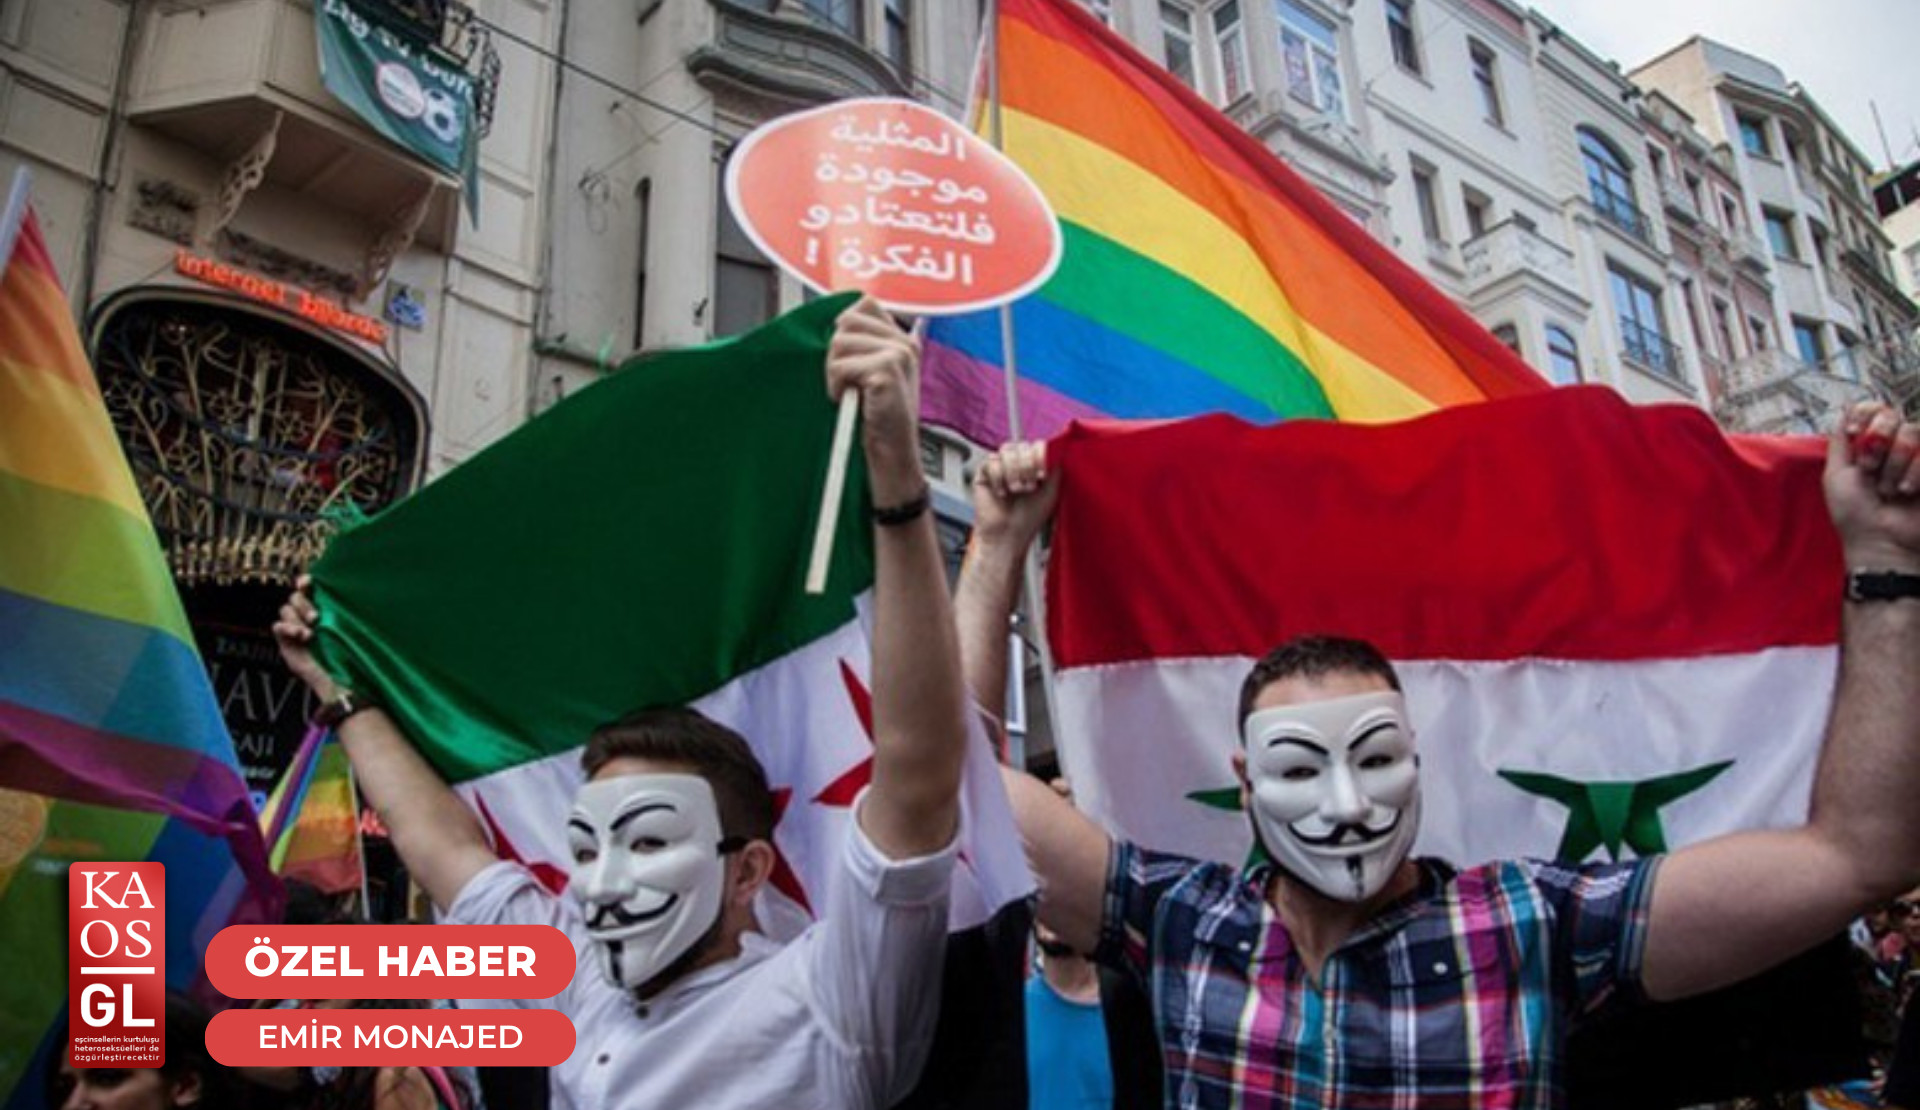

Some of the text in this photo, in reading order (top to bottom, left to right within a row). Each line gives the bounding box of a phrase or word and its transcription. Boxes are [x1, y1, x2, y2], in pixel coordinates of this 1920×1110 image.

[831, 113, 967, 160] المثلية
[815, 153, 988, 203] موجودة
[799, 196, 996, 245] فلتعتادو
[837, 237, 974, 286] الفكرة
